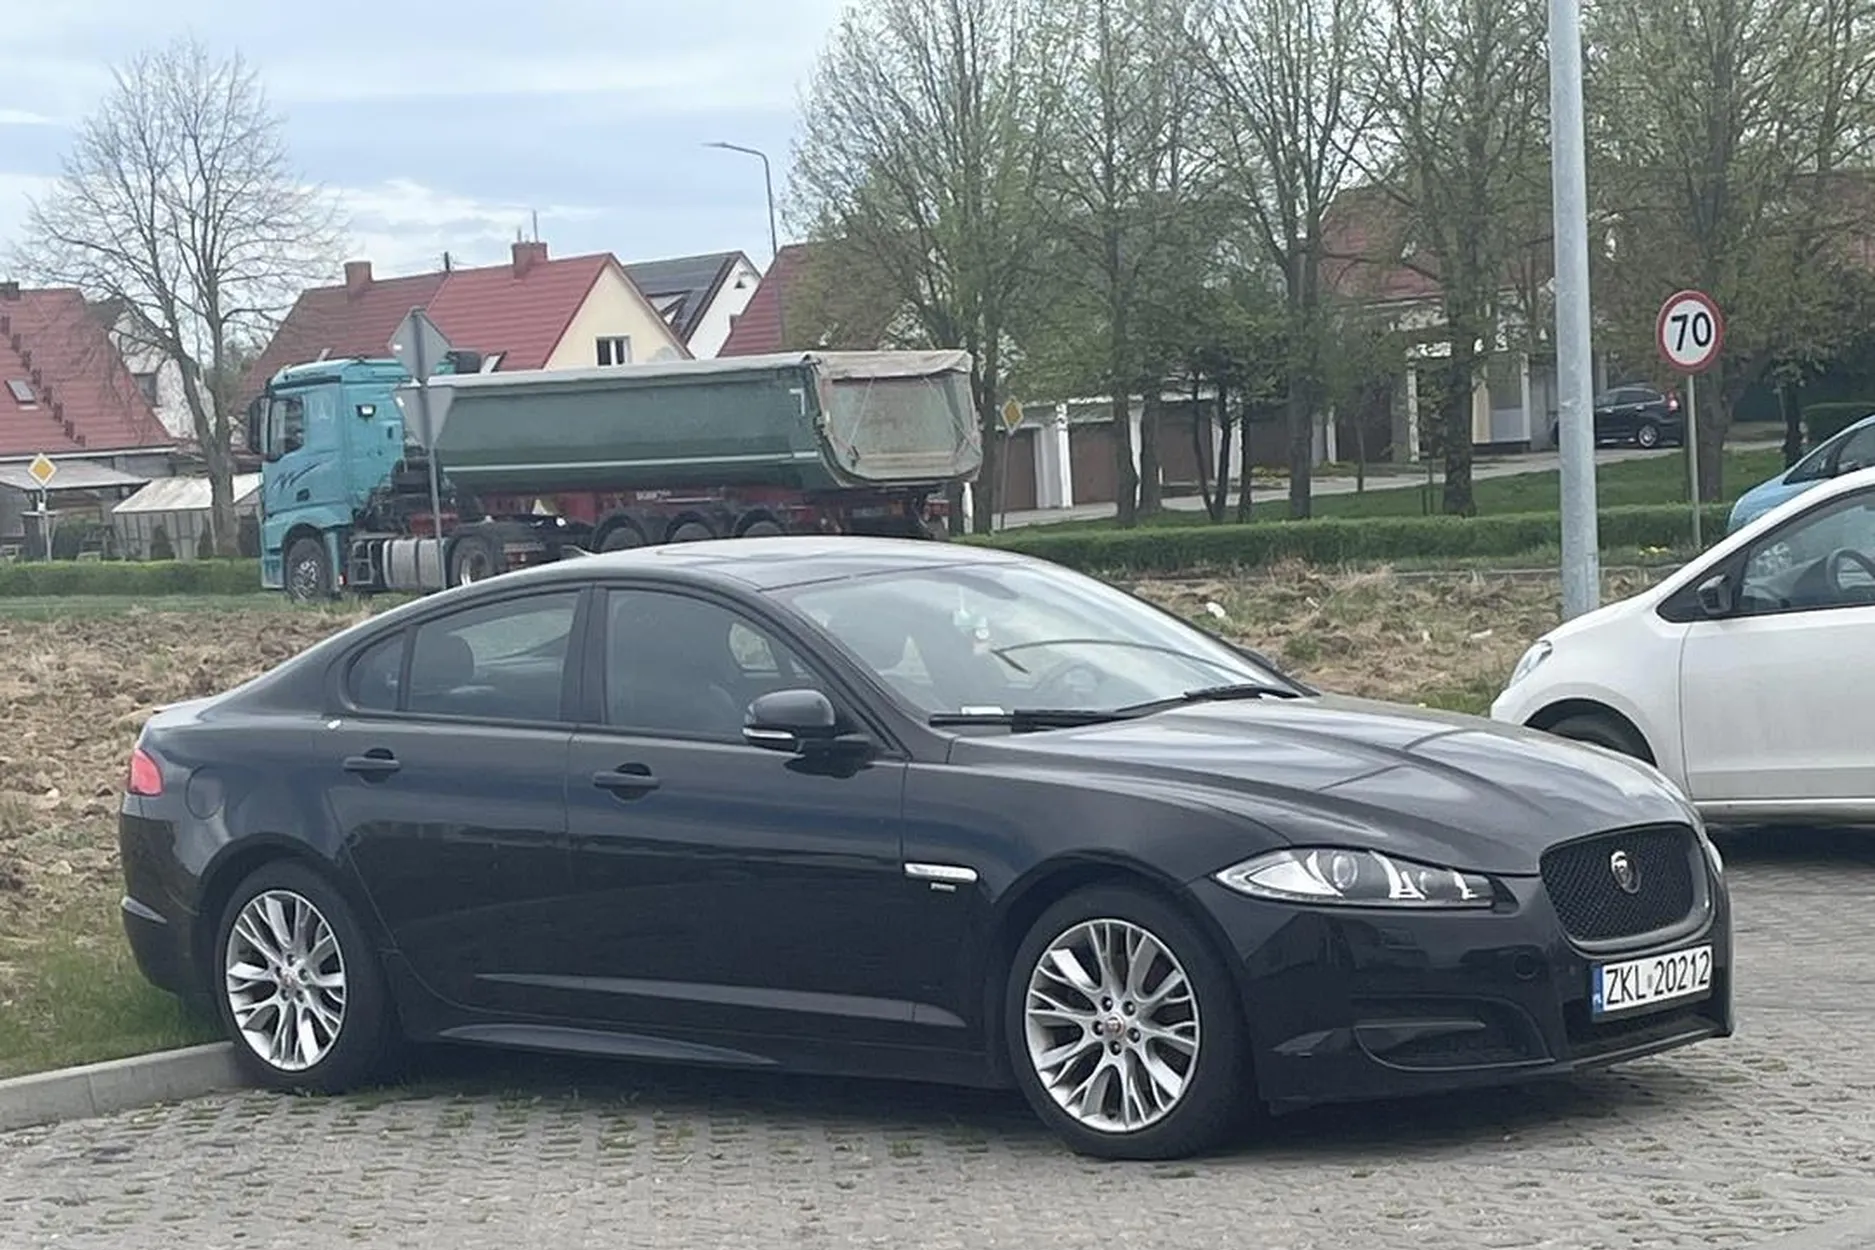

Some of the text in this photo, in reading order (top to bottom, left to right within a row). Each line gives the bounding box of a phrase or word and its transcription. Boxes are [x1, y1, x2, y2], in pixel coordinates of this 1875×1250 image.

[1671, 312, 1712, 351] 70
[1605, 950, 1710, 1005] ZKL 20212
